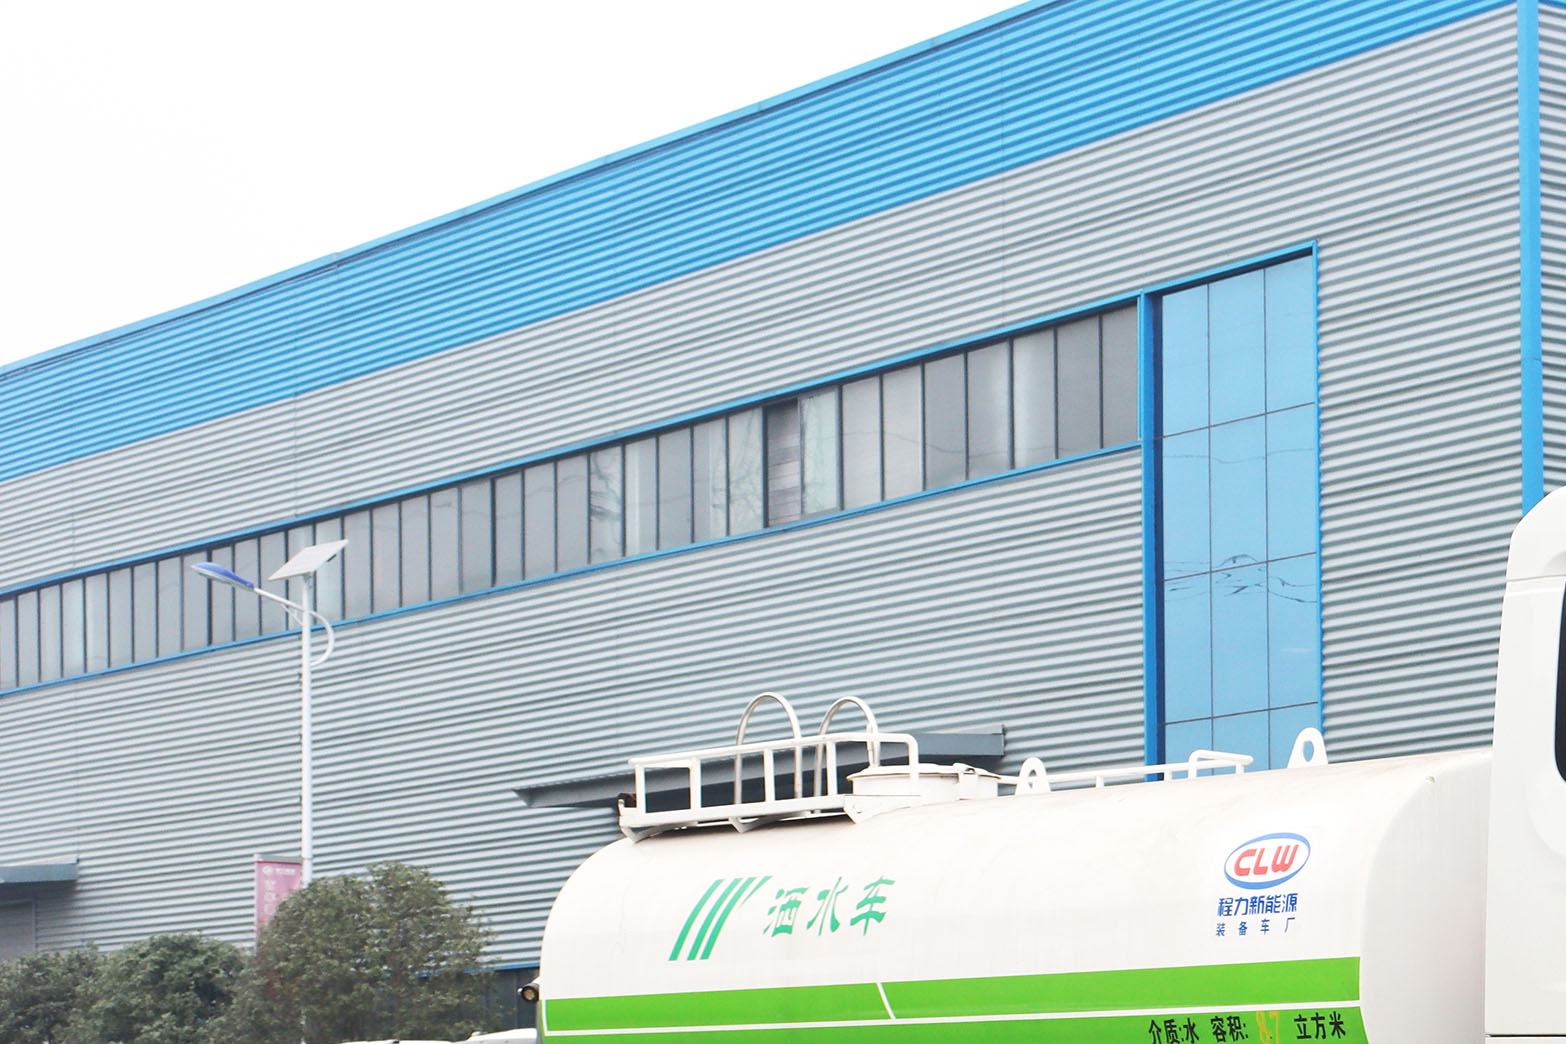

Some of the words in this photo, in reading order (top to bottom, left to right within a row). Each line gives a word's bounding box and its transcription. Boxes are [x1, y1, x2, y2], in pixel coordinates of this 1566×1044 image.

[1234, 843, 1300, 877] CLW
[762, 875, 896, 938] 洒水车
[1217, 892, 1299, 917] 程力新能源
[1293, 1010, 1347, 1040] 立方米
